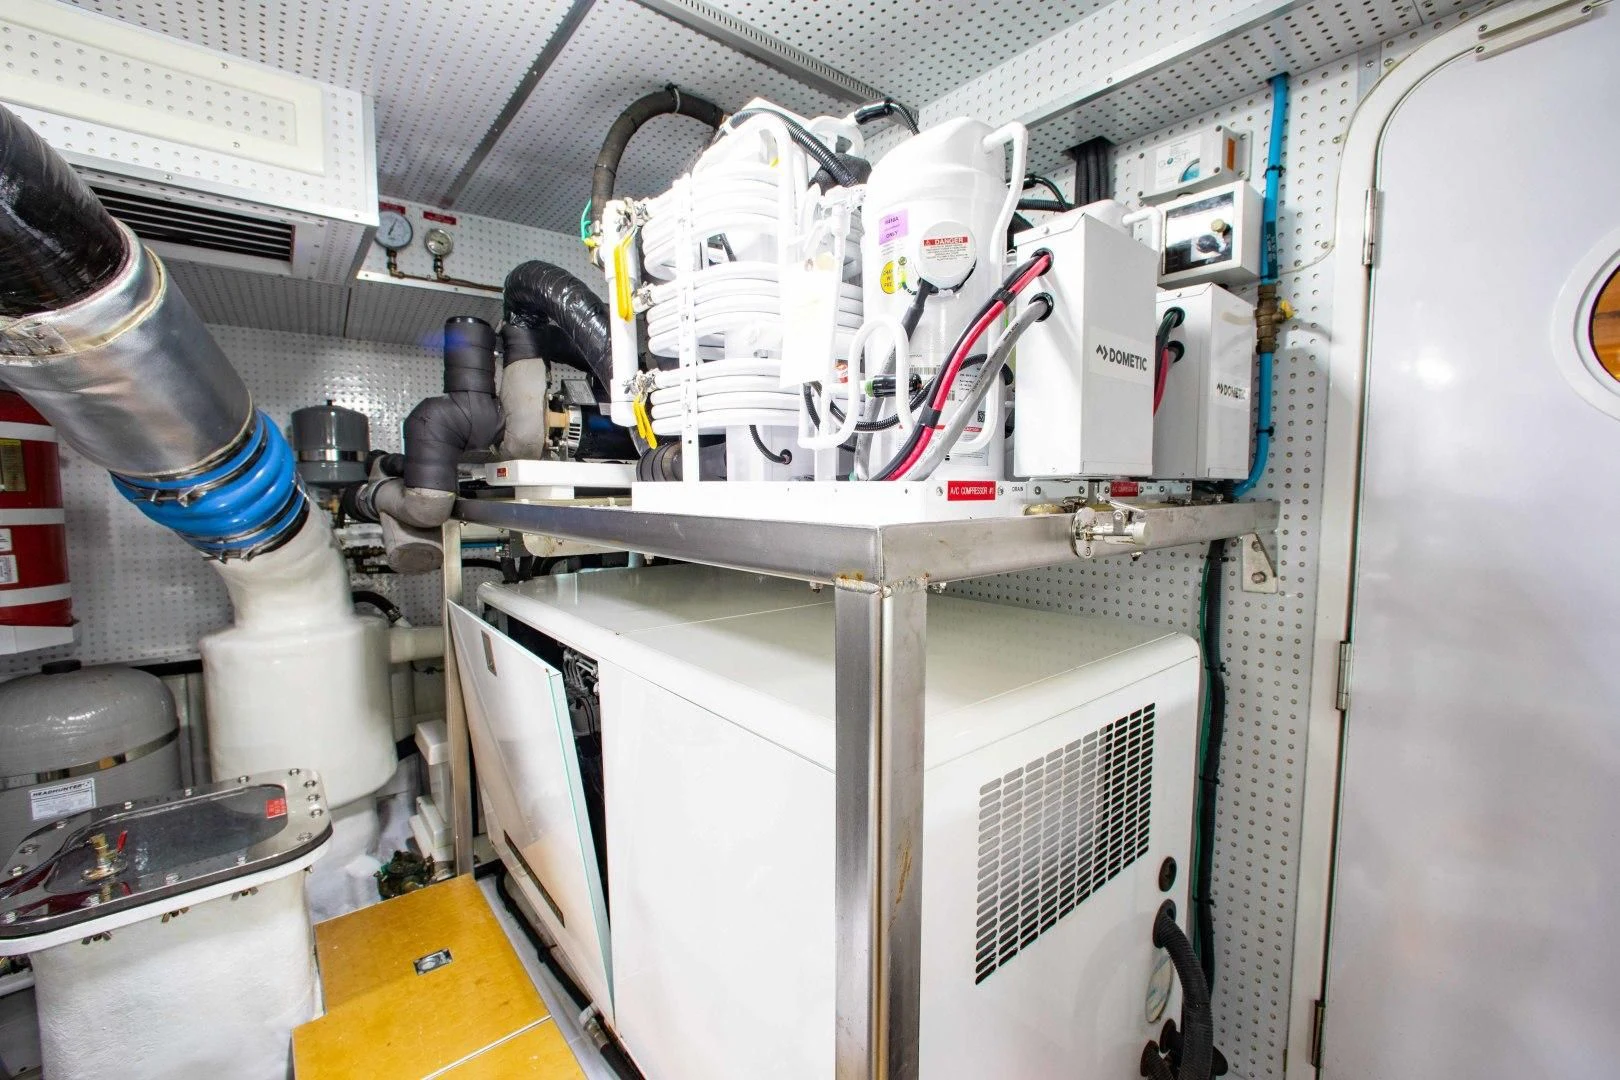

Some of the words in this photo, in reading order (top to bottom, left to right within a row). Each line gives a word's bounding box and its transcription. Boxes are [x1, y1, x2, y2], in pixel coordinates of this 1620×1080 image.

[934, 237, 963, 245] DANGER
[1109, 347, 1147, 371] DOMETIC
[950, 486, 960, 495] A/C
[961, 486, 988, 495] COMPRESSOR
[32, 783, 84, 797] HEADHUNTER
